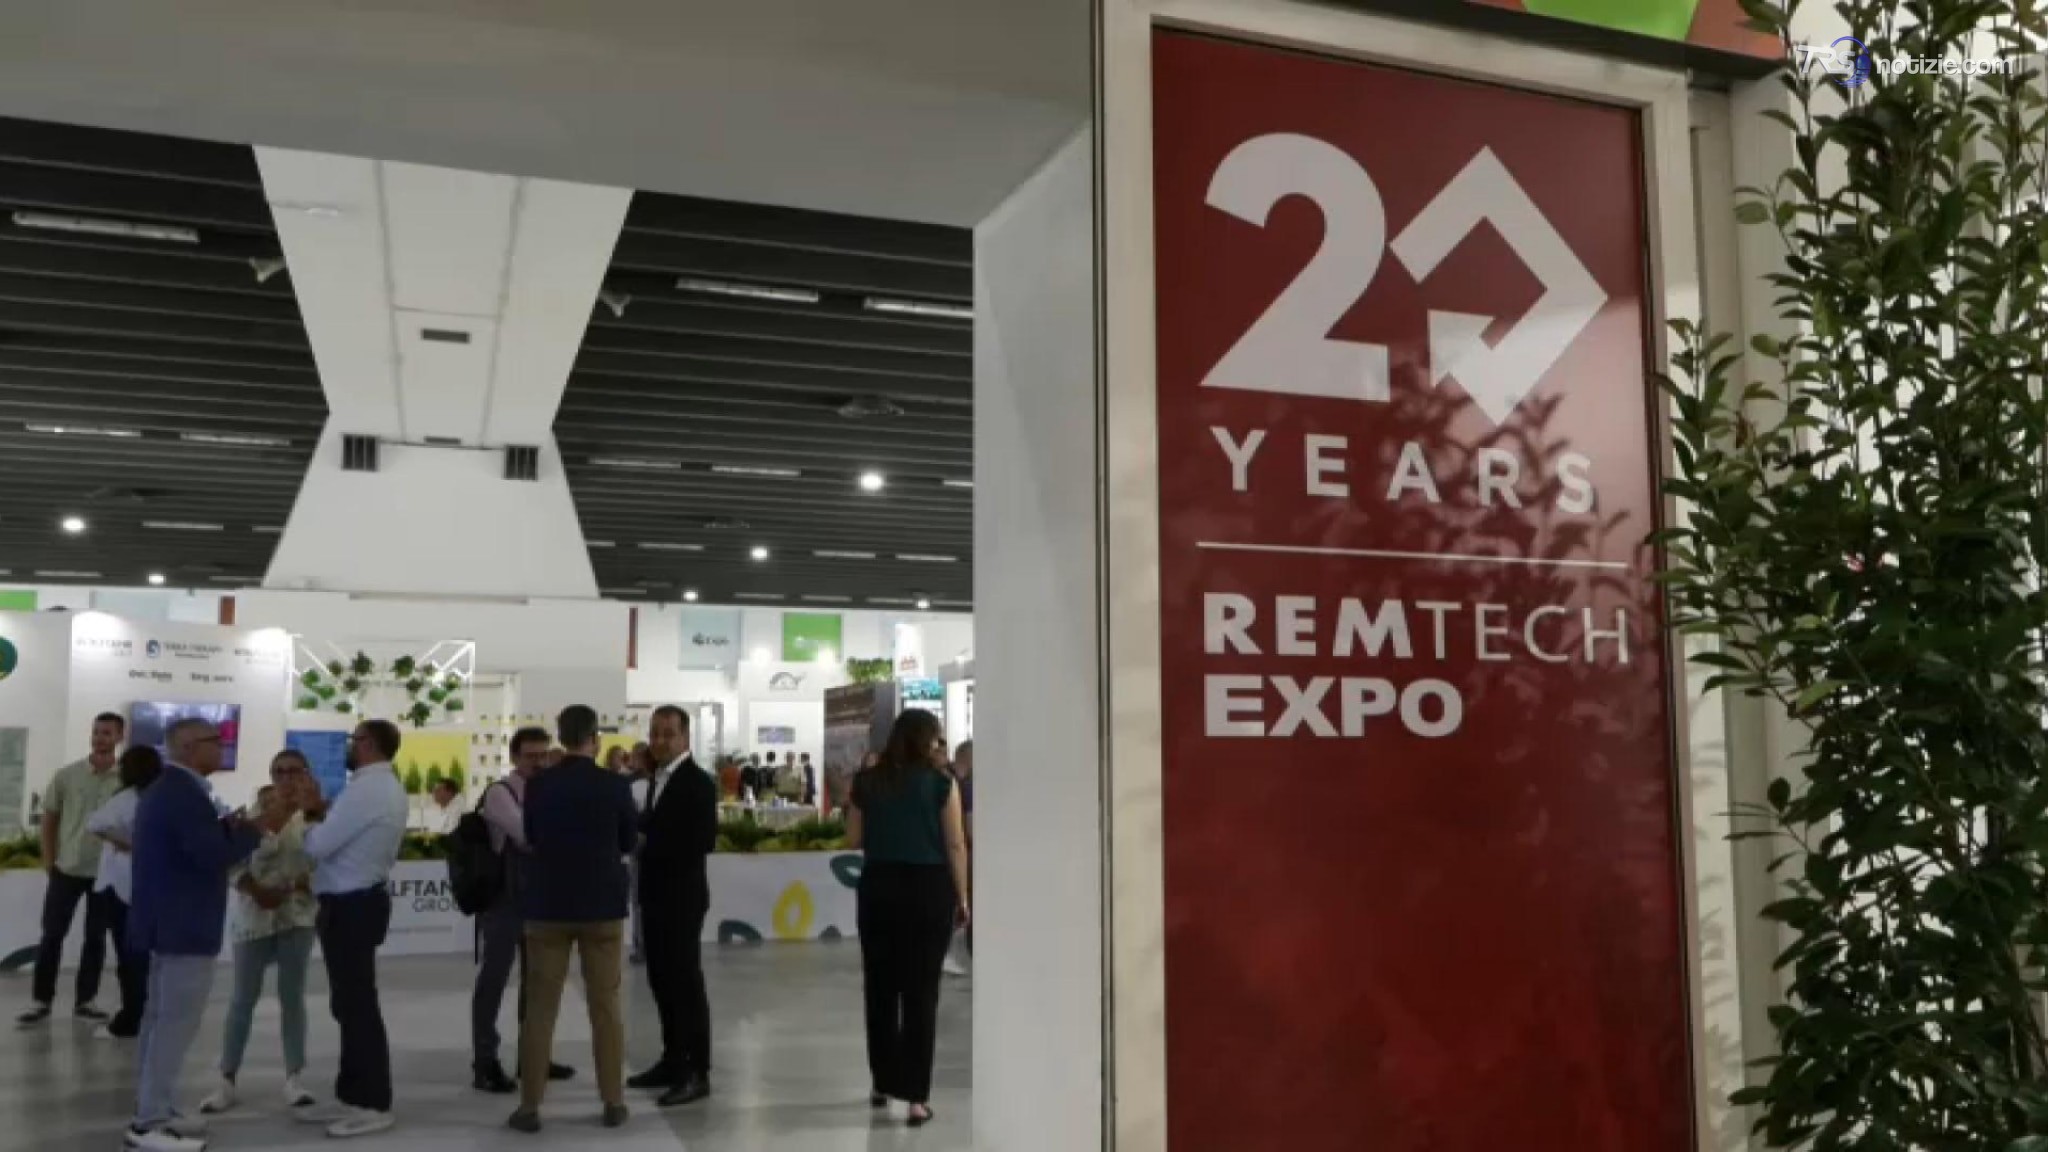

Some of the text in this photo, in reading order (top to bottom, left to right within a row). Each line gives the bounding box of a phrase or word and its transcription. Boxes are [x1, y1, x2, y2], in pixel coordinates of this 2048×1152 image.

[1209, 426, 1595, 513] YEARS
[1203, 592, 1630, 664] REMTECH
[1203, 673, 1464, 738] EXPO
